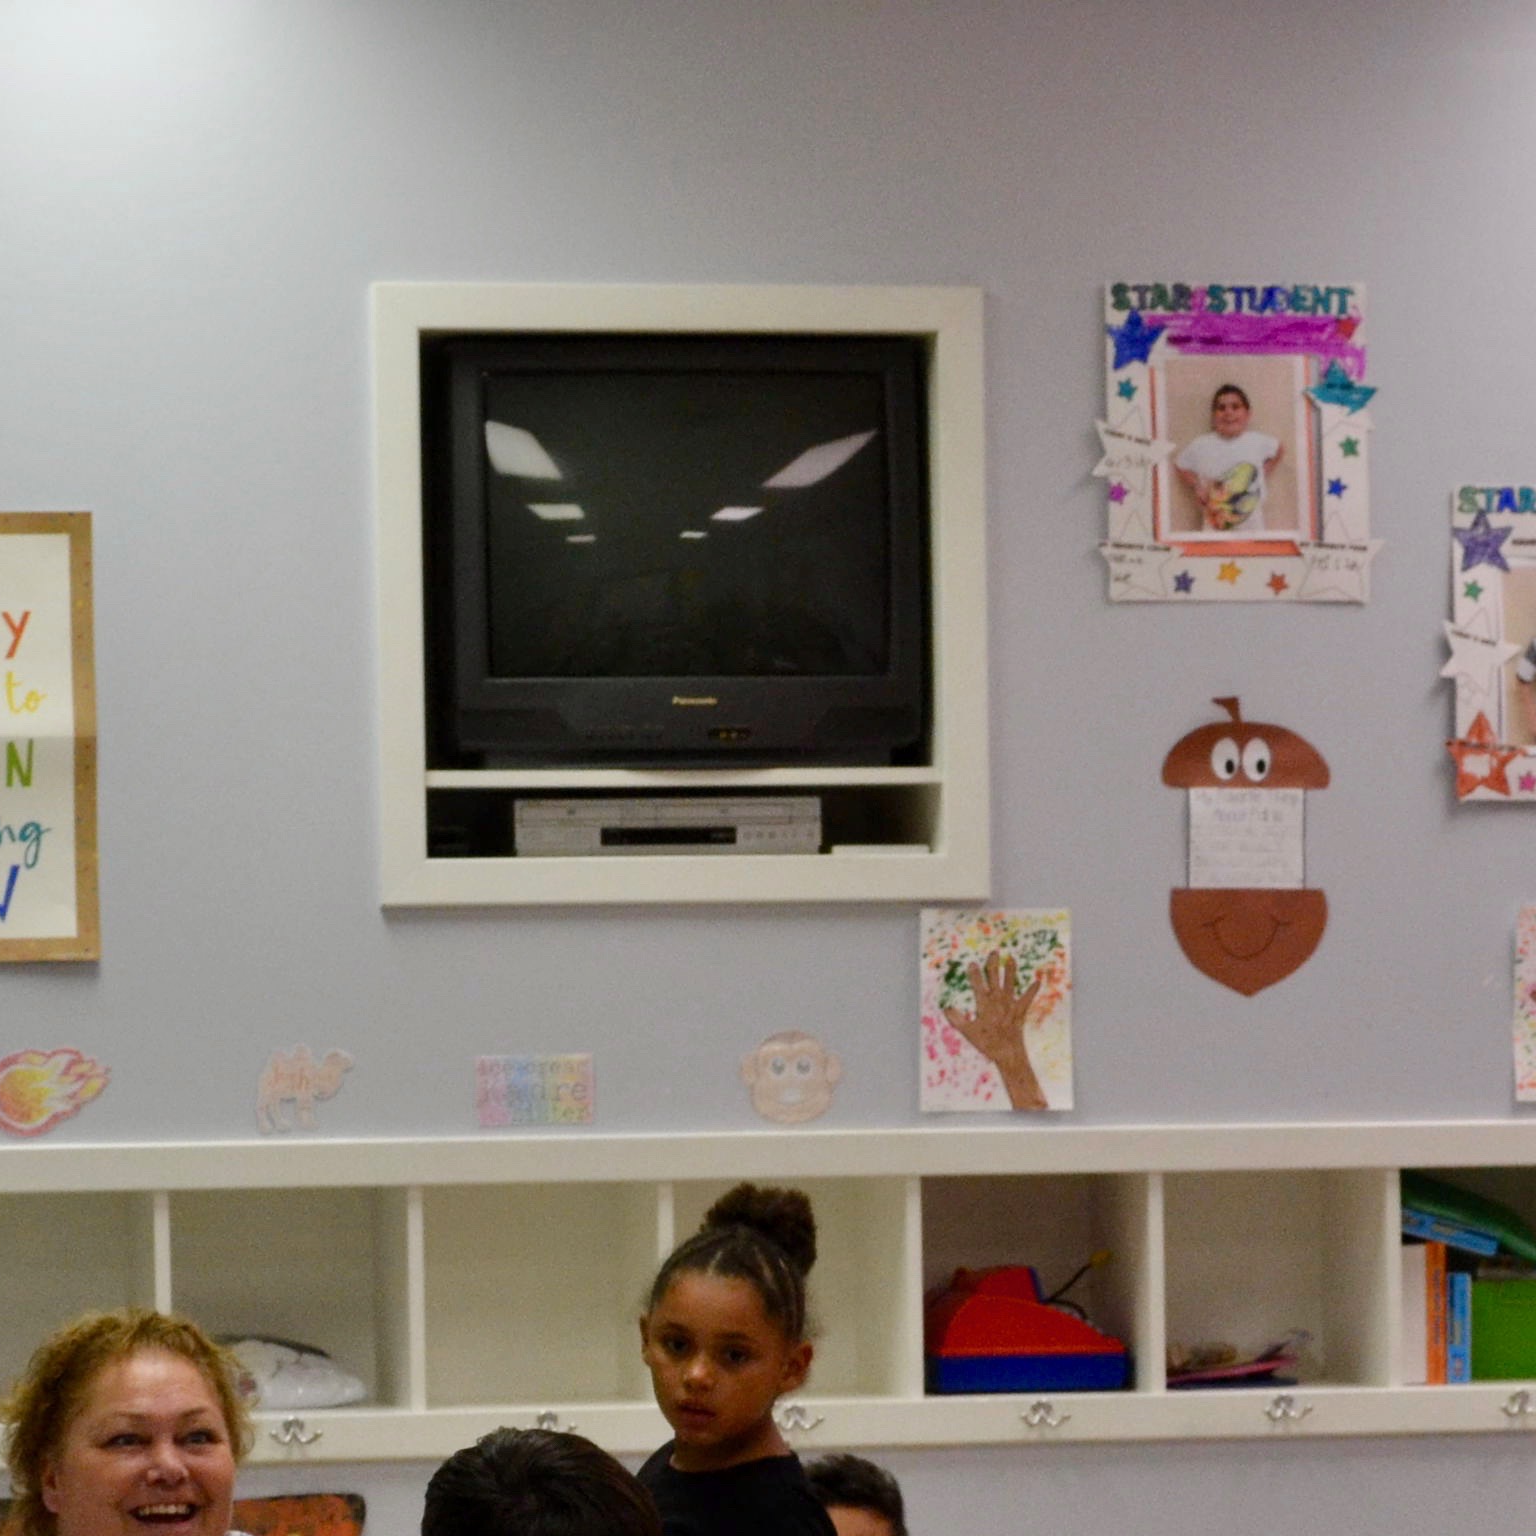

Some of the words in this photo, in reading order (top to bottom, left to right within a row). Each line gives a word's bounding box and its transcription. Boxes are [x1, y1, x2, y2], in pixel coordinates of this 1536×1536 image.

[1110, 282, 1192, 312] STAR
[1207, 284, 1355, 315] STUDENT
[4, 671, 47, 716] to
